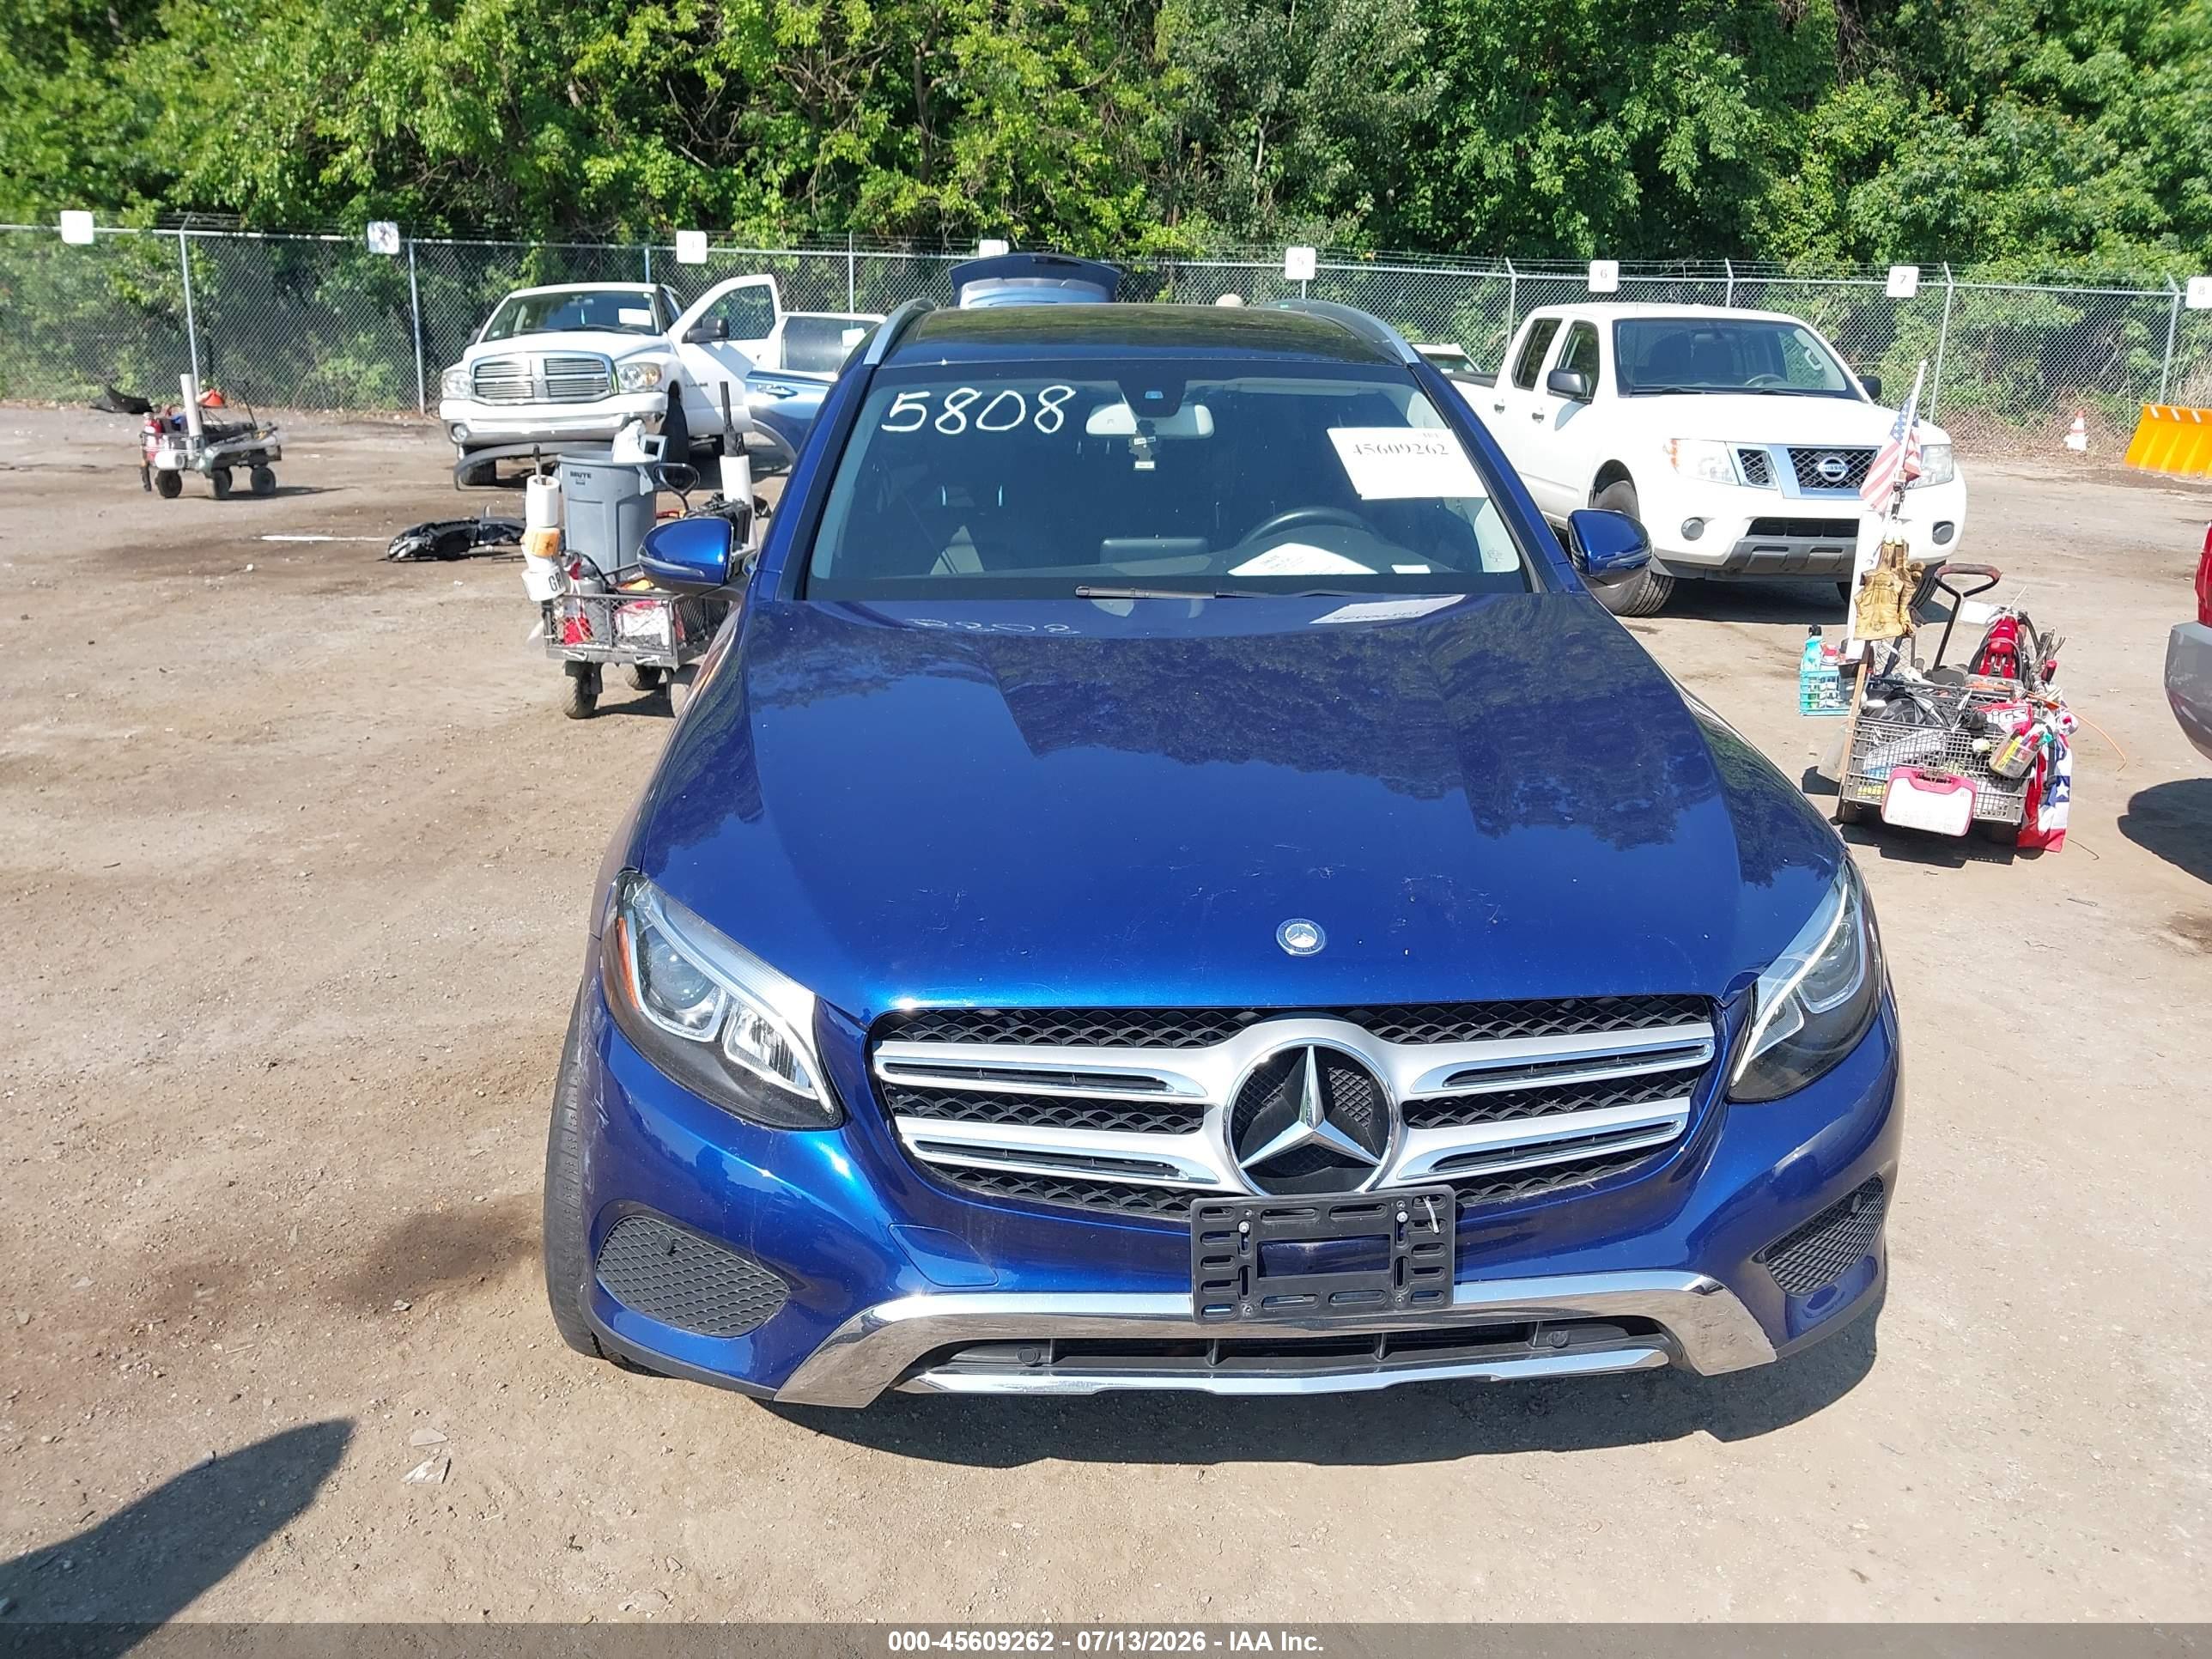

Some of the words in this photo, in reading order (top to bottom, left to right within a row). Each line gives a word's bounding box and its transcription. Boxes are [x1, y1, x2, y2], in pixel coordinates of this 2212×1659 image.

[1600, 267, 1607, 279] 6
[1899, 273, 1908, 284] 7
[2197, 284, 2206, 295] 8
[881, 385, 1076, 434] 5808
[1352, 443, 1449, 455] 45609262
